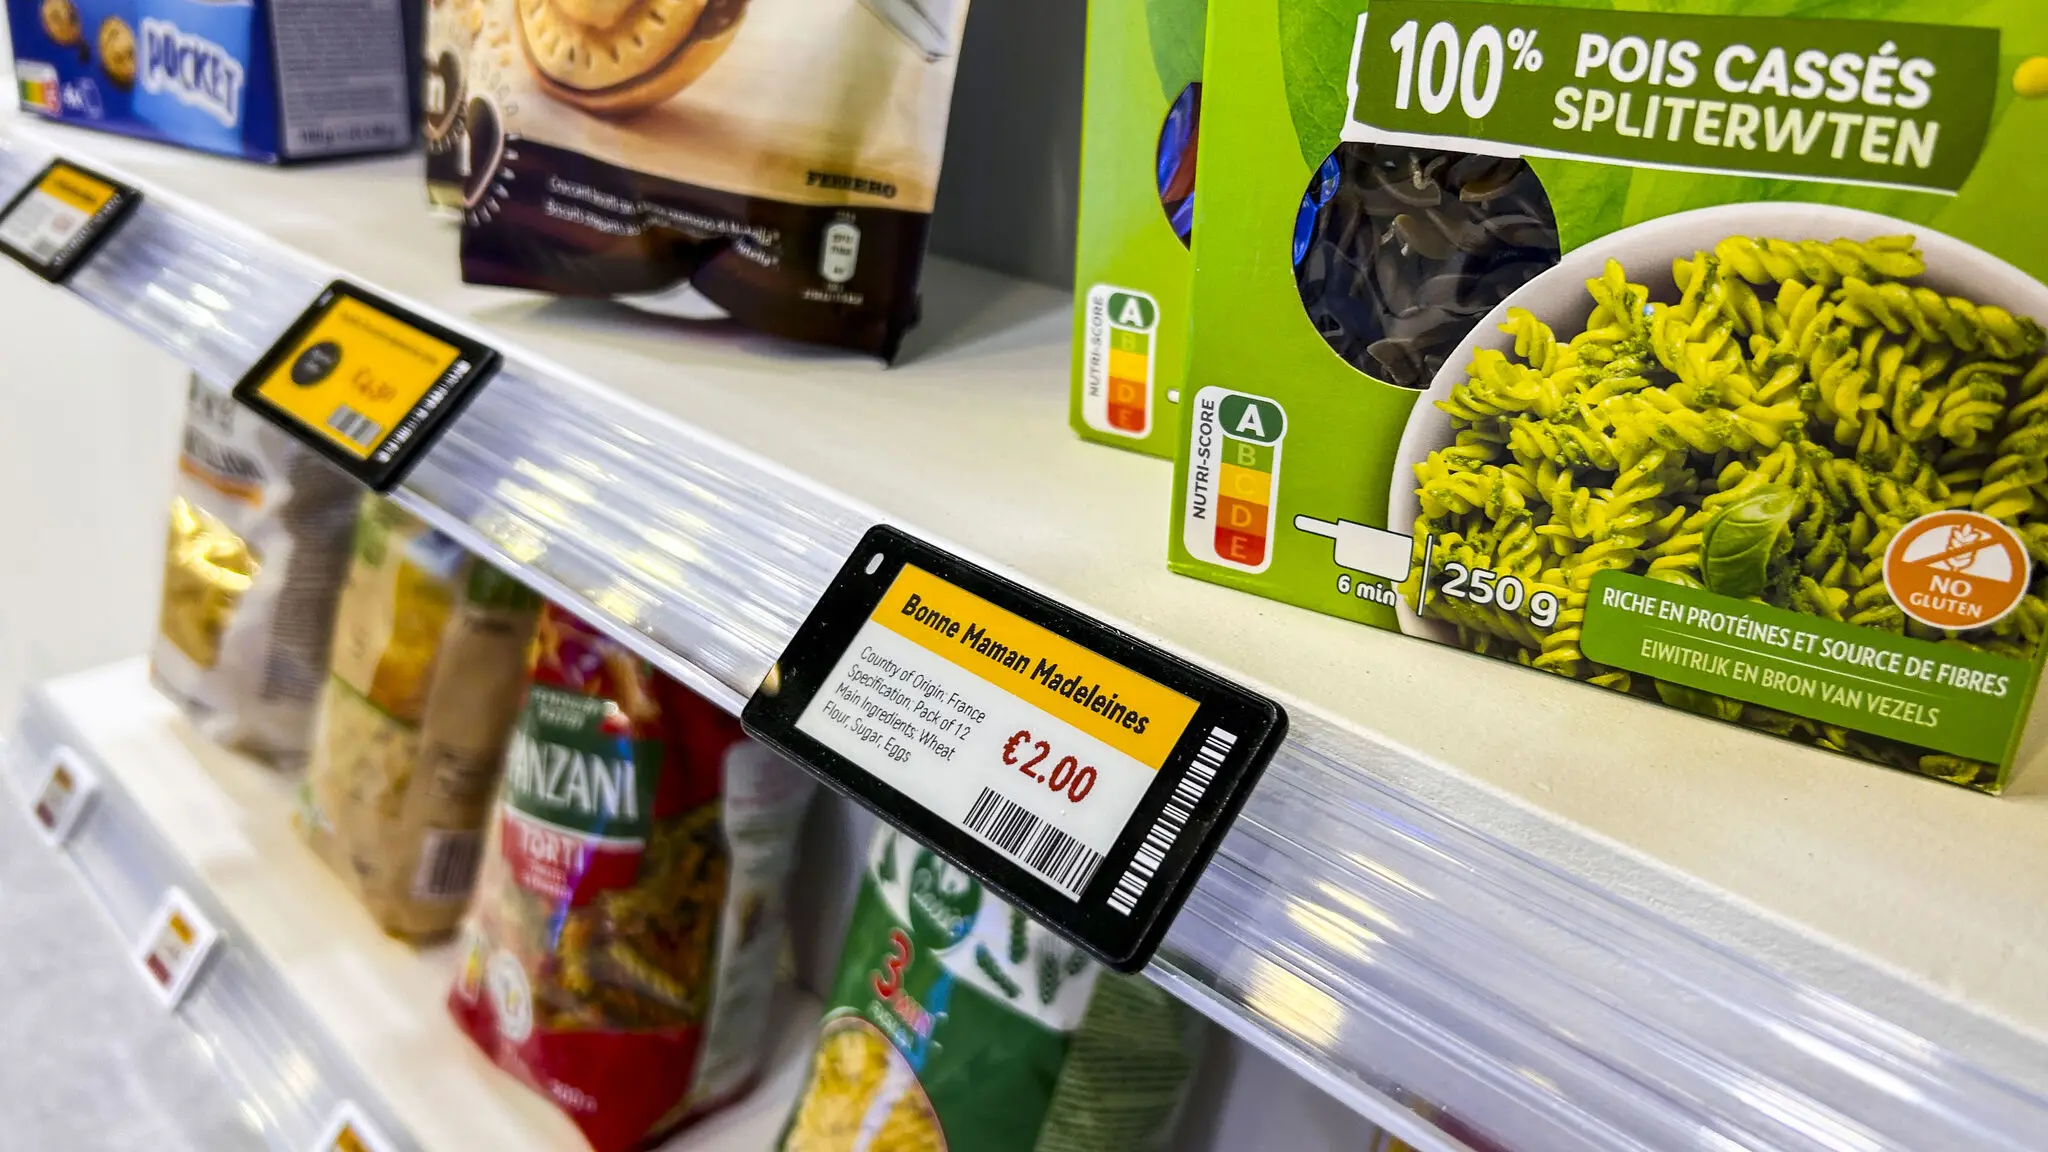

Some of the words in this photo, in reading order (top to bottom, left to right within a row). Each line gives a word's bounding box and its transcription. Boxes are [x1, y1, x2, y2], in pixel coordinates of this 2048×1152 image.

[145, 27, 240, 118] POCKET
[1390, 19, 1543, 119] 100%
[1574, 32, 1701, 87] POIS
[1713, 41, 1936, 110] CASSÉS
[1553, 87, 1939, 169] SPLITERWTEN
[1088, 296, 1103, 397] NUTRI-SCORE
[1118, 298, 1144, 328] A
[1117, 383, 1135, 402] D
[1236, 403, 1266, 438] A
[1192, 399, 1214, 519] NUTRI-SCORE
[1234, 474, 1255, 495] C
[1237, 444, 1256, 466] B
[1230, 536, 1248, 560] E
[1231, 505, 1252, 528] D
[1337, 573, 1352, 594] 6
[1355, 580, 1397, 607] min
[1441, 562, 1524, 612] 250
[1529, 591, 1560, 628] g
[1910, 592, 1983, 618] GLUTEN
[1929, 575, 1972, 598] NO
[901, 593, 960, 638] Bonne
[960, 623, 1031, 675] Maman
[1030, 658, 1150, 735] Madeleines
[1602, 587, 1657, 616] RICHE
[1658, 600, 1684, 623] EN
[1686, 606, 1791, 648] PROTÉINES
[1792, 631, 1819, 654] ET
[1819, 637, 1902, 674] SOURCE
[1904, 656, 1935, 681] DE
[1936, 663, 2010, 698] FIBRES
[860, 646, 901, 678] Country
[900, 670, 916, 683] of
[947, 692, 986, 724] France
[1640, 638, 1731, 678] EIWITRIJK
[1732, 662, 1759, 684] EN
[1761, 668, 1816, 699] BRON
[1821, 682, 1861, 710] VAN
[1867, 692, 1941, 728] VEZELS
[822, 701, 851, 729] Flour,
[851, 717, 883, 748] Sugar,
[884, 737, 912, 763] Eggs
[835, 682, 860, 706] Main
[919, 729, 956, 761] Wheat
[913, 701, 942, 725] Pack
[940, 718, 957, 731] of
[954, 723, 972, 741] 12
[506, 728, 640, 823] ANZANI
[1002, 730, 1098, 804] €2.00
[869, 929, 914, 1000] 3
